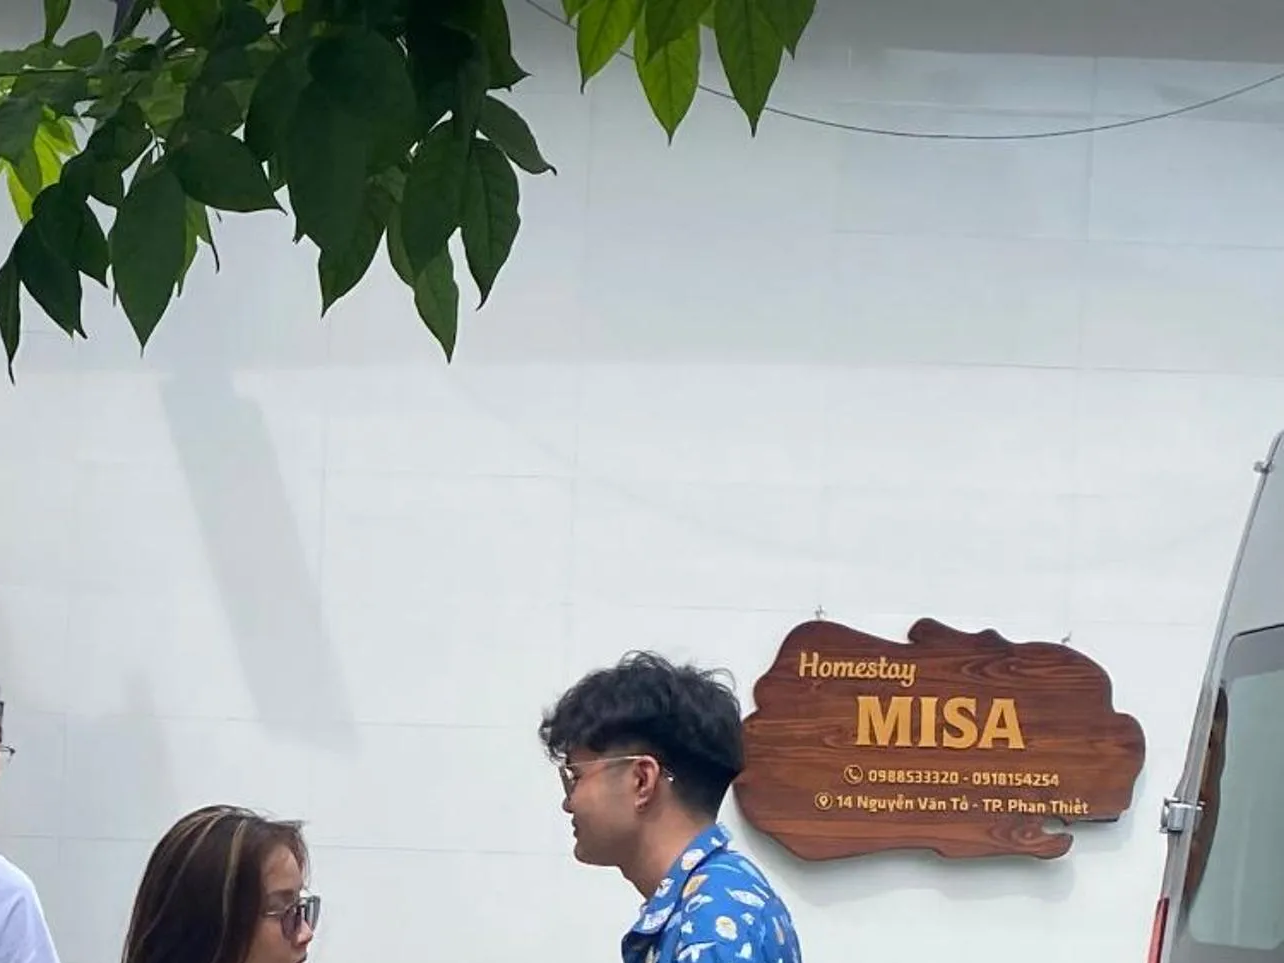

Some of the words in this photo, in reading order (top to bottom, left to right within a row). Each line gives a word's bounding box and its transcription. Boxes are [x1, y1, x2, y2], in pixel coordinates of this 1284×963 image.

[798, 652, 916, 687] Homestay
[856, 695, 1025, 749] MISA
[868, 769, 959, 785] 0988533320
[972, 773, 1060, 787] 0918154254
[836, 795, 853, 809] 14
[1008, 799, 1046, 814] Phan
